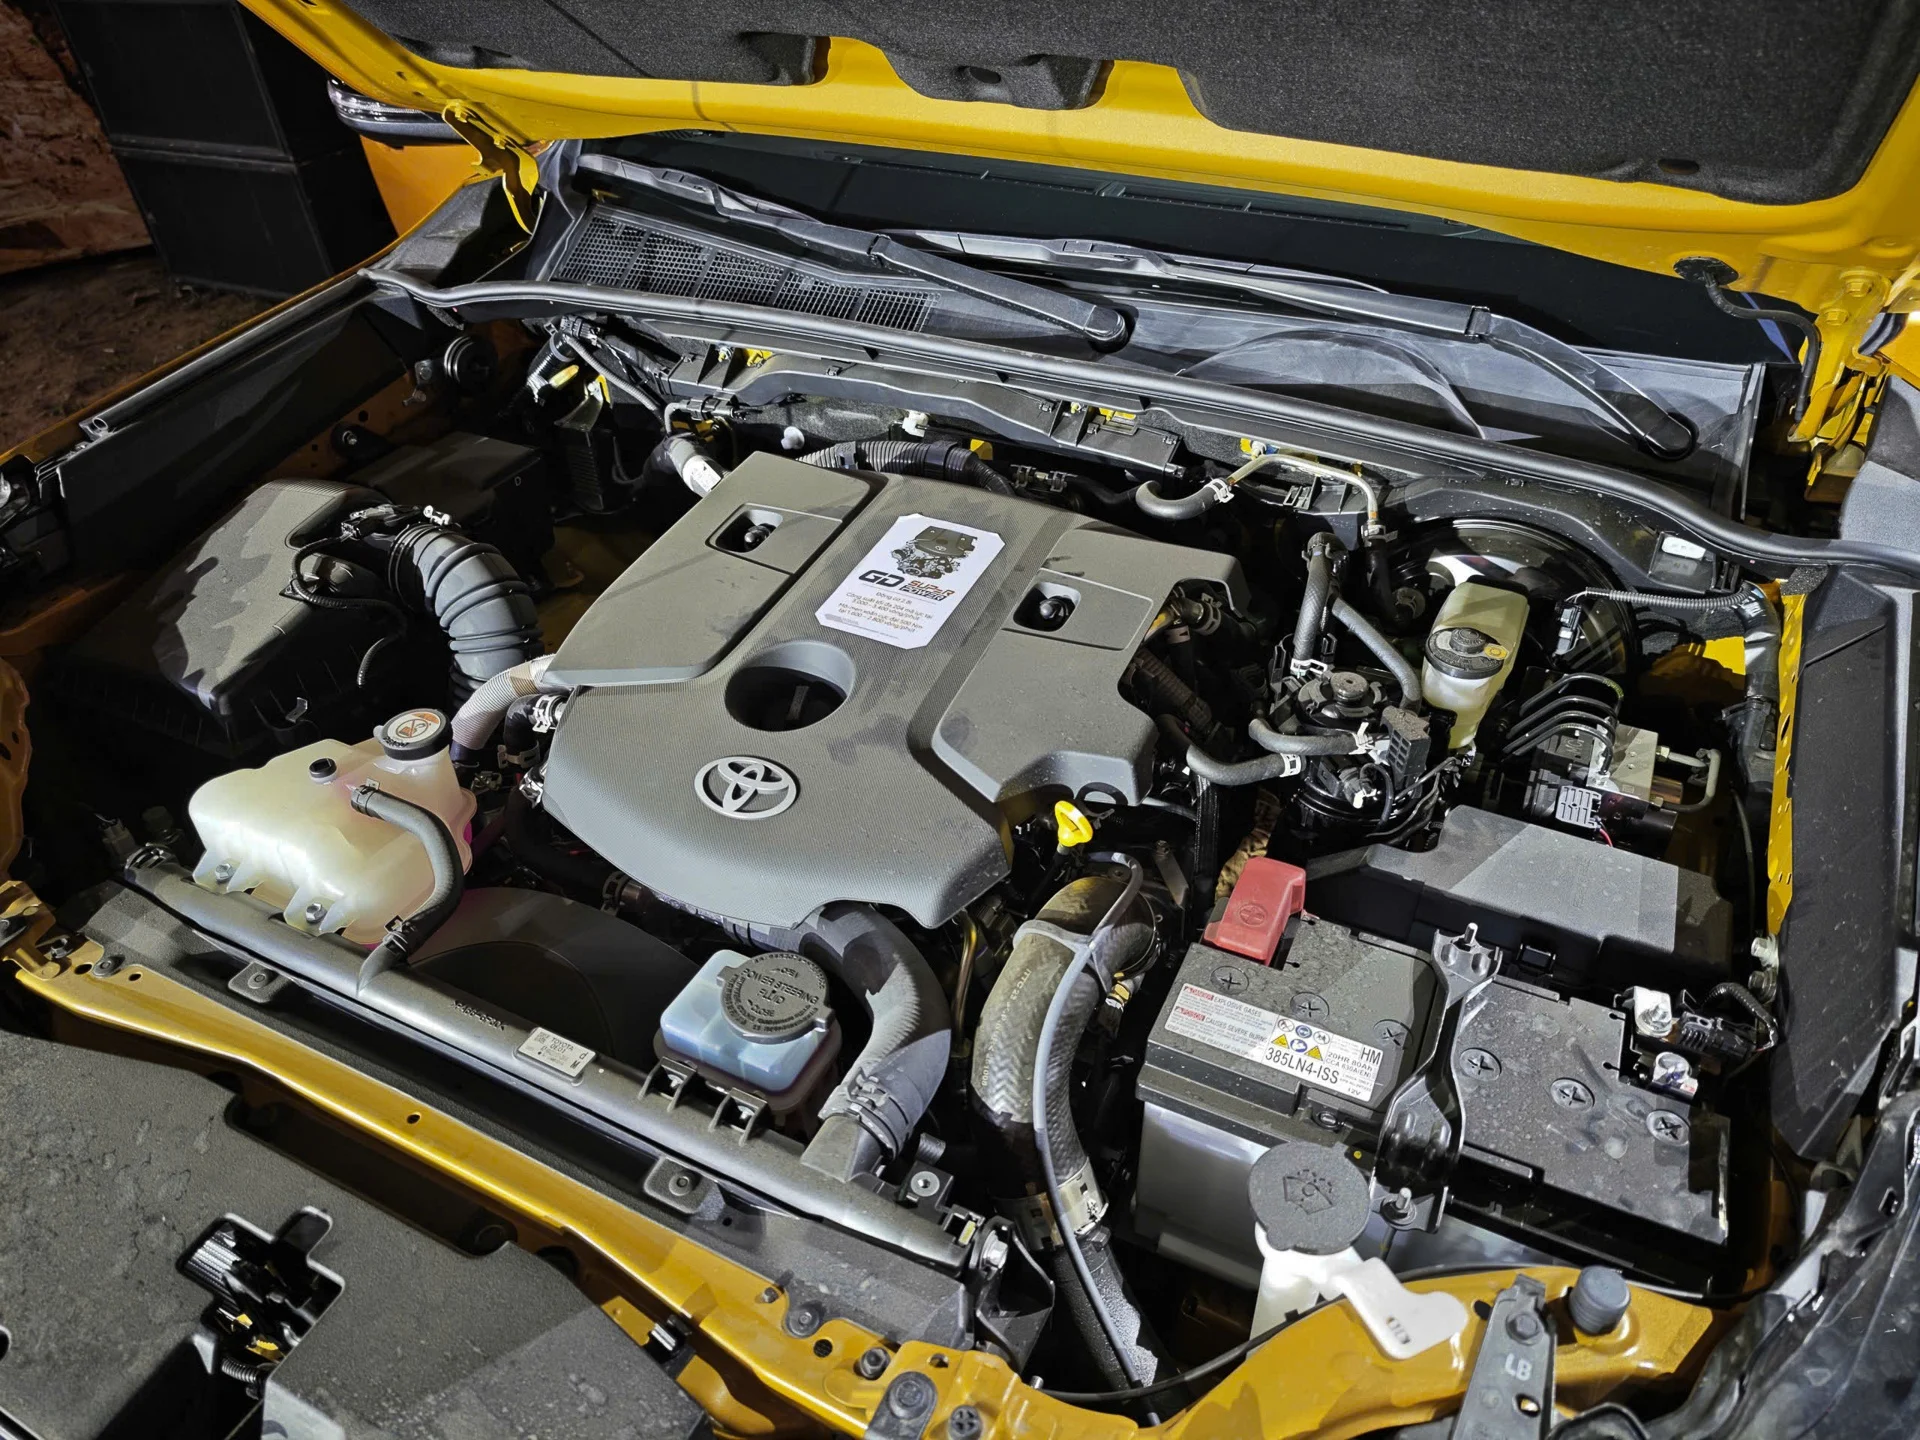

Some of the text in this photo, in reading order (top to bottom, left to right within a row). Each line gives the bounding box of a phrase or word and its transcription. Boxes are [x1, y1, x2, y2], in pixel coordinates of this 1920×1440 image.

[859, 569, 905, 587] GD
[743, 967, 775, 986] POWER
[774, 981, 819, 1005] STEERING
[1214, 996, 1242, 1010] EXPLOSIVE
[1244, 1007, 1261, 1017] GASES
[1206, 1017, 1227, 1028] CAUSES
[1228, 1025, 1247, 1036] SEVERE
[551, 1037, 574, 1050] TOYOTA
[1325, 1057, 1339, 1066] CCA
[1328, 1051, 1372, 1071] 20HR 80Ah
[1361, 1046, 1381, 1065] HM
[1265, 1047, 1339, 1084] 385LN4-ISS
[1505, 1353, 1533, 1381] LB
